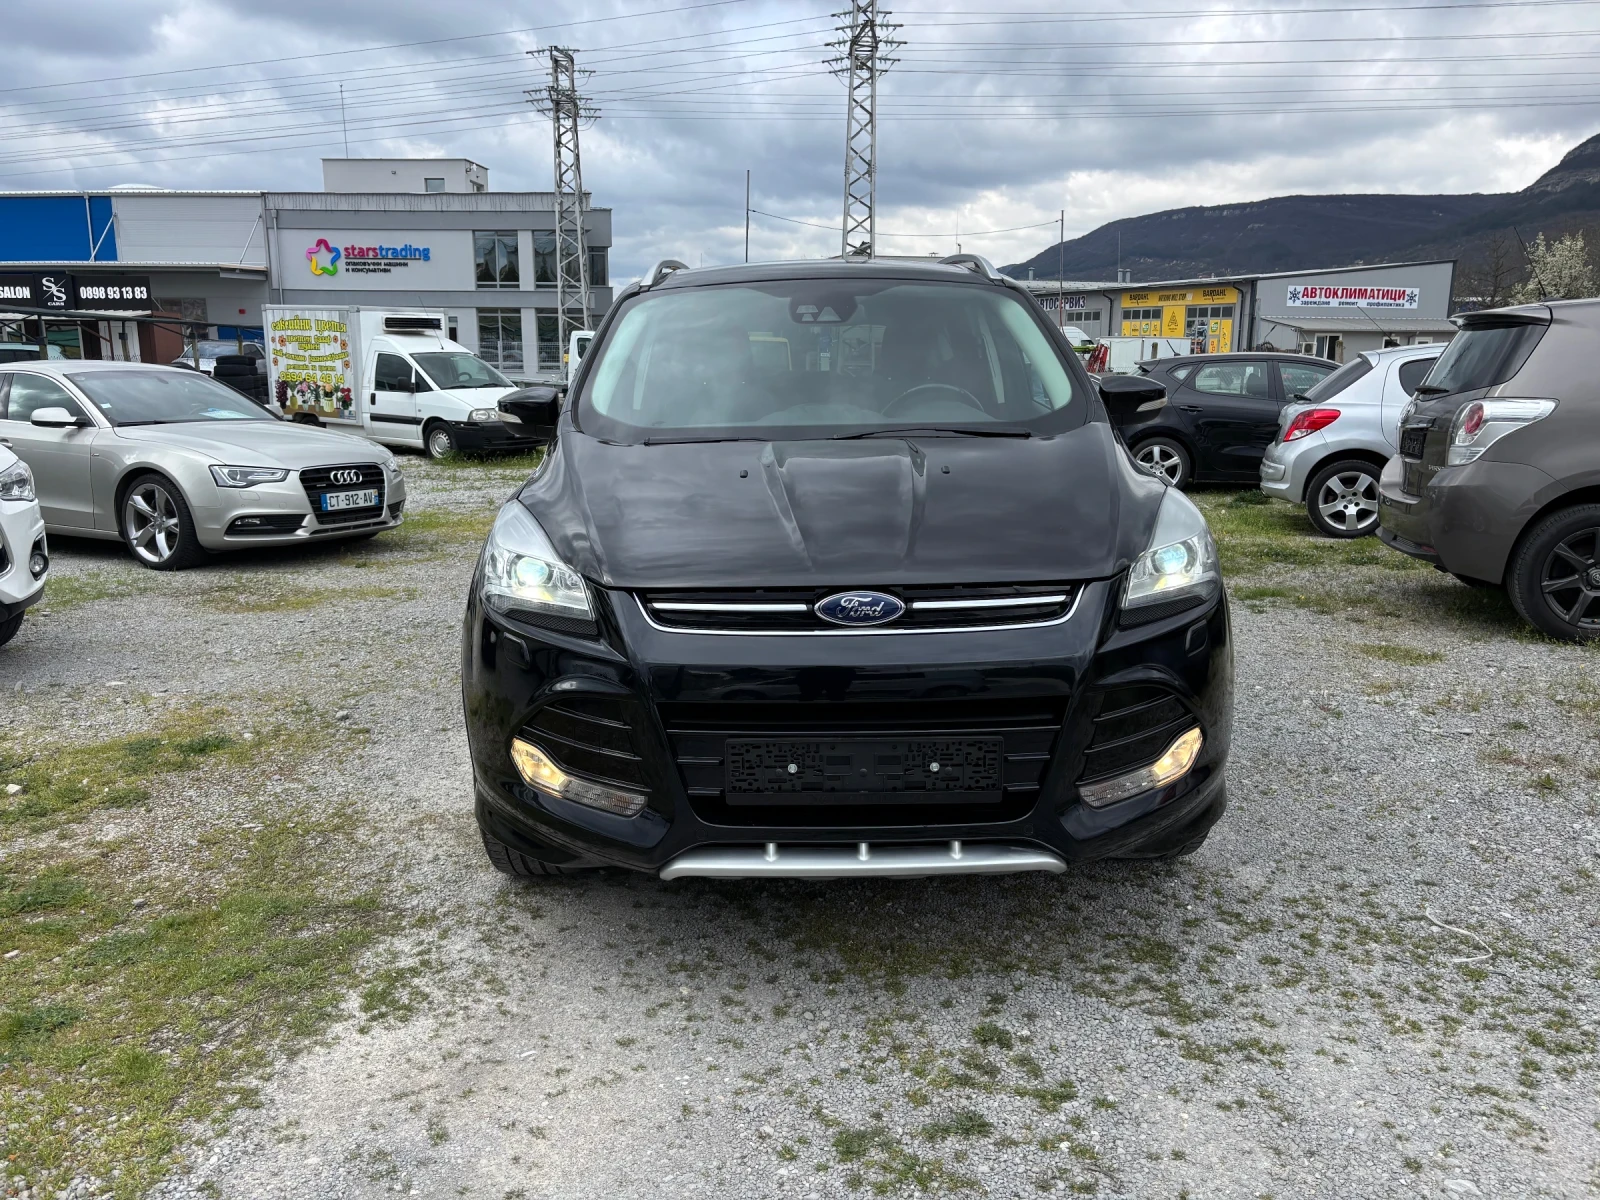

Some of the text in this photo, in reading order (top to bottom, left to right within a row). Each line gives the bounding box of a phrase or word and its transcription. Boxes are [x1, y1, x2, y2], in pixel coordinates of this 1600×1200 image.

[344, 244, 430, 261] starstrading
[79, 286, 147, 299] 0898 93 13 83
[1129, 293, 1149, 303] BARDAHL
[1202, 288, 1227, 299] BARDAHL
[1301, 287, 1406, 301] АВТОКЛИМАТИЦИ
[1038, 296, 1086, 310] ВТОСЕРВИЗ
[305, 372, 317, 383] 64
[320, 373, 332, 384] 48
[334, 374, 345, 384] 14
[329, 492, 373, 508] CT-912-AV
[836, 596, 885, 617] Ford
